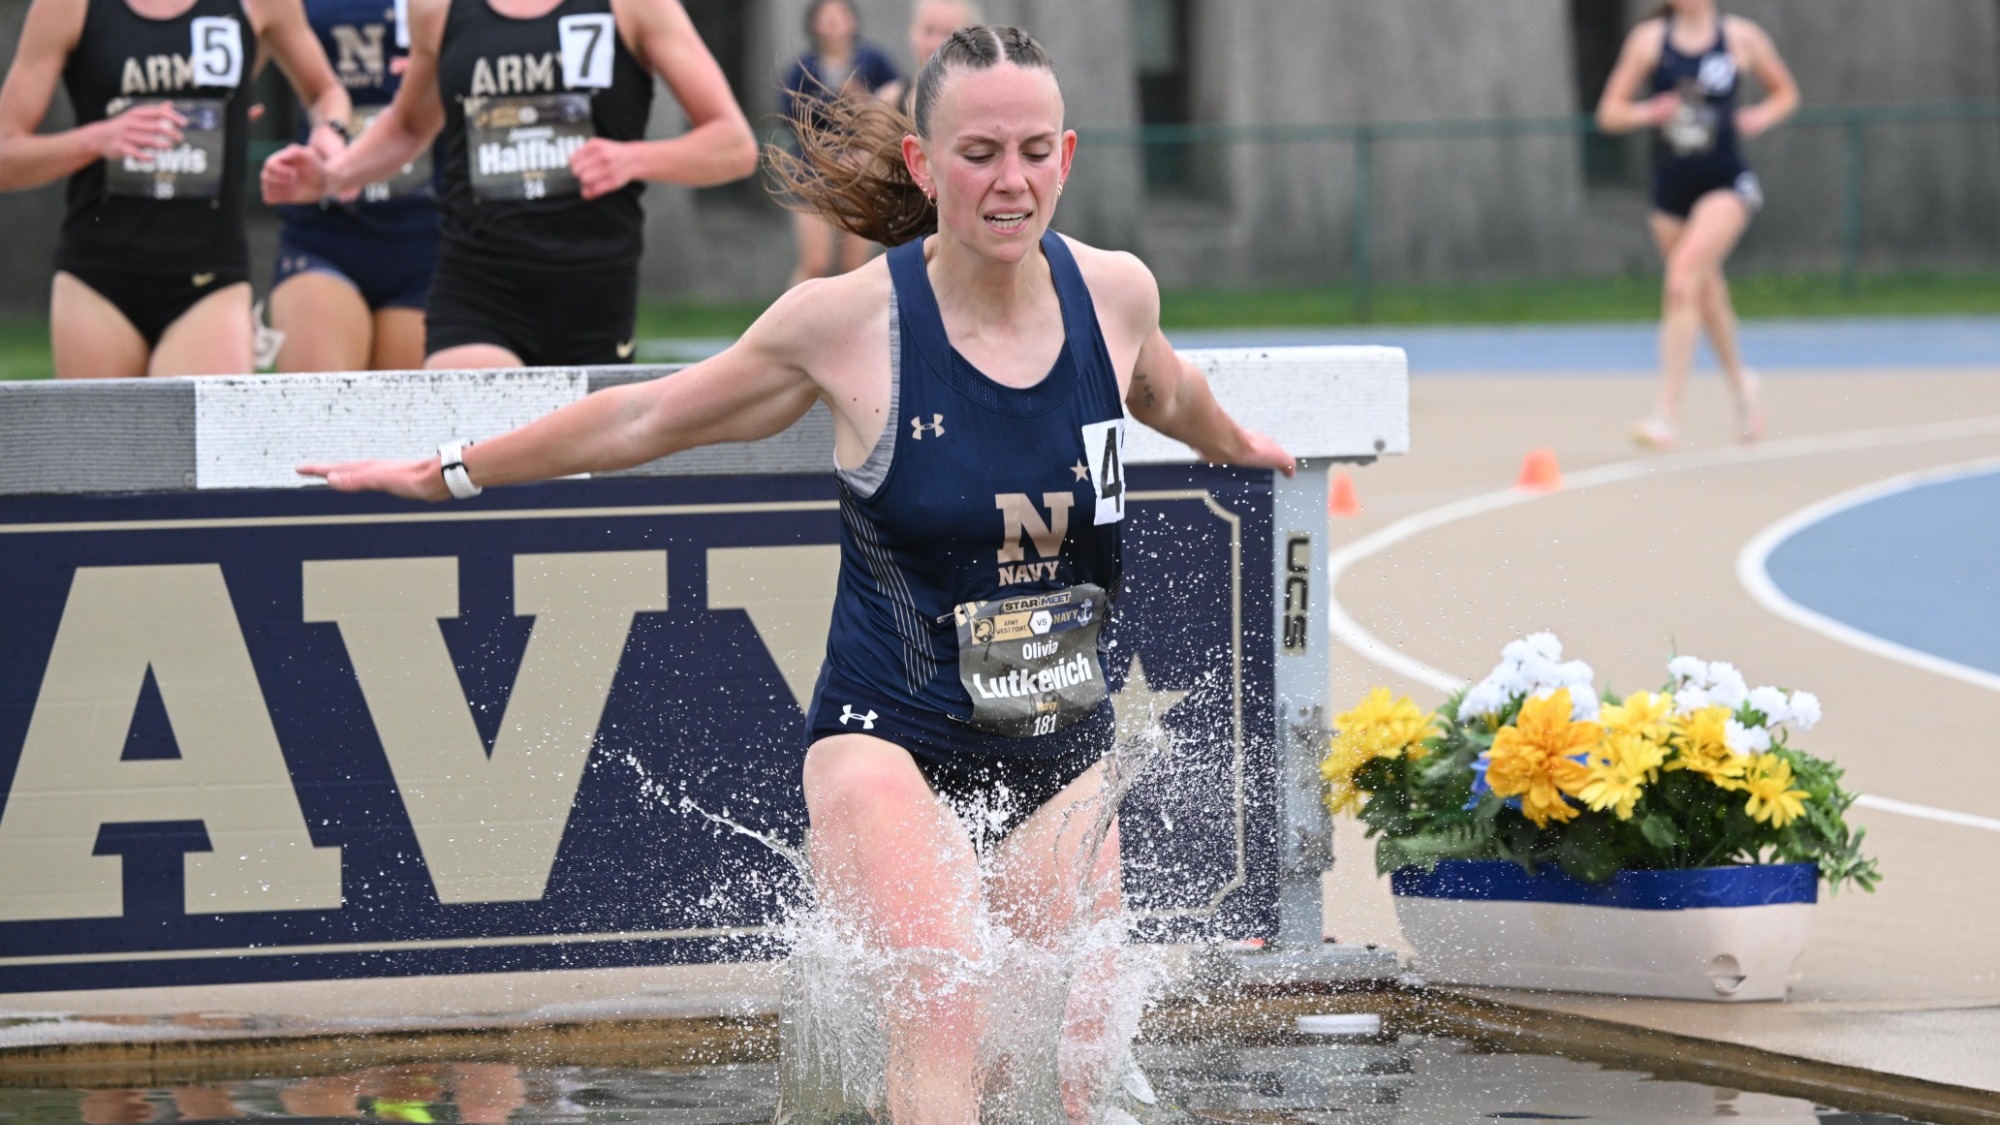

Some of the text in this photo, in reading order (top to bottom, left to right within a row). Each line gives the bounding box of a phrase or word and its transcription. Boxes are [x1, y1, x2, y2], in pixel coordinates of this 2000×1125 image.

[203, 26, 232, 76] 5
[331, 25, 385, 74] N
[569, 24, 603, 79] 7
[122, 53, 197, 95] ARM
[1101, 427, 1122, 513] 4
[995, 491, 1075, 564] N
[998, 560, 1059, 587] NAVY
[1004, 593, 1071, 613] STAR MEET
[1036, 619, 1048, 627] VS
[1052, 608, 1079, 625] NAVY
[1022, 640, 1059, 661] Olivia
[972, 652, 1093, 699] Lutkevich
[1032, 713, 1057, 737] 181
